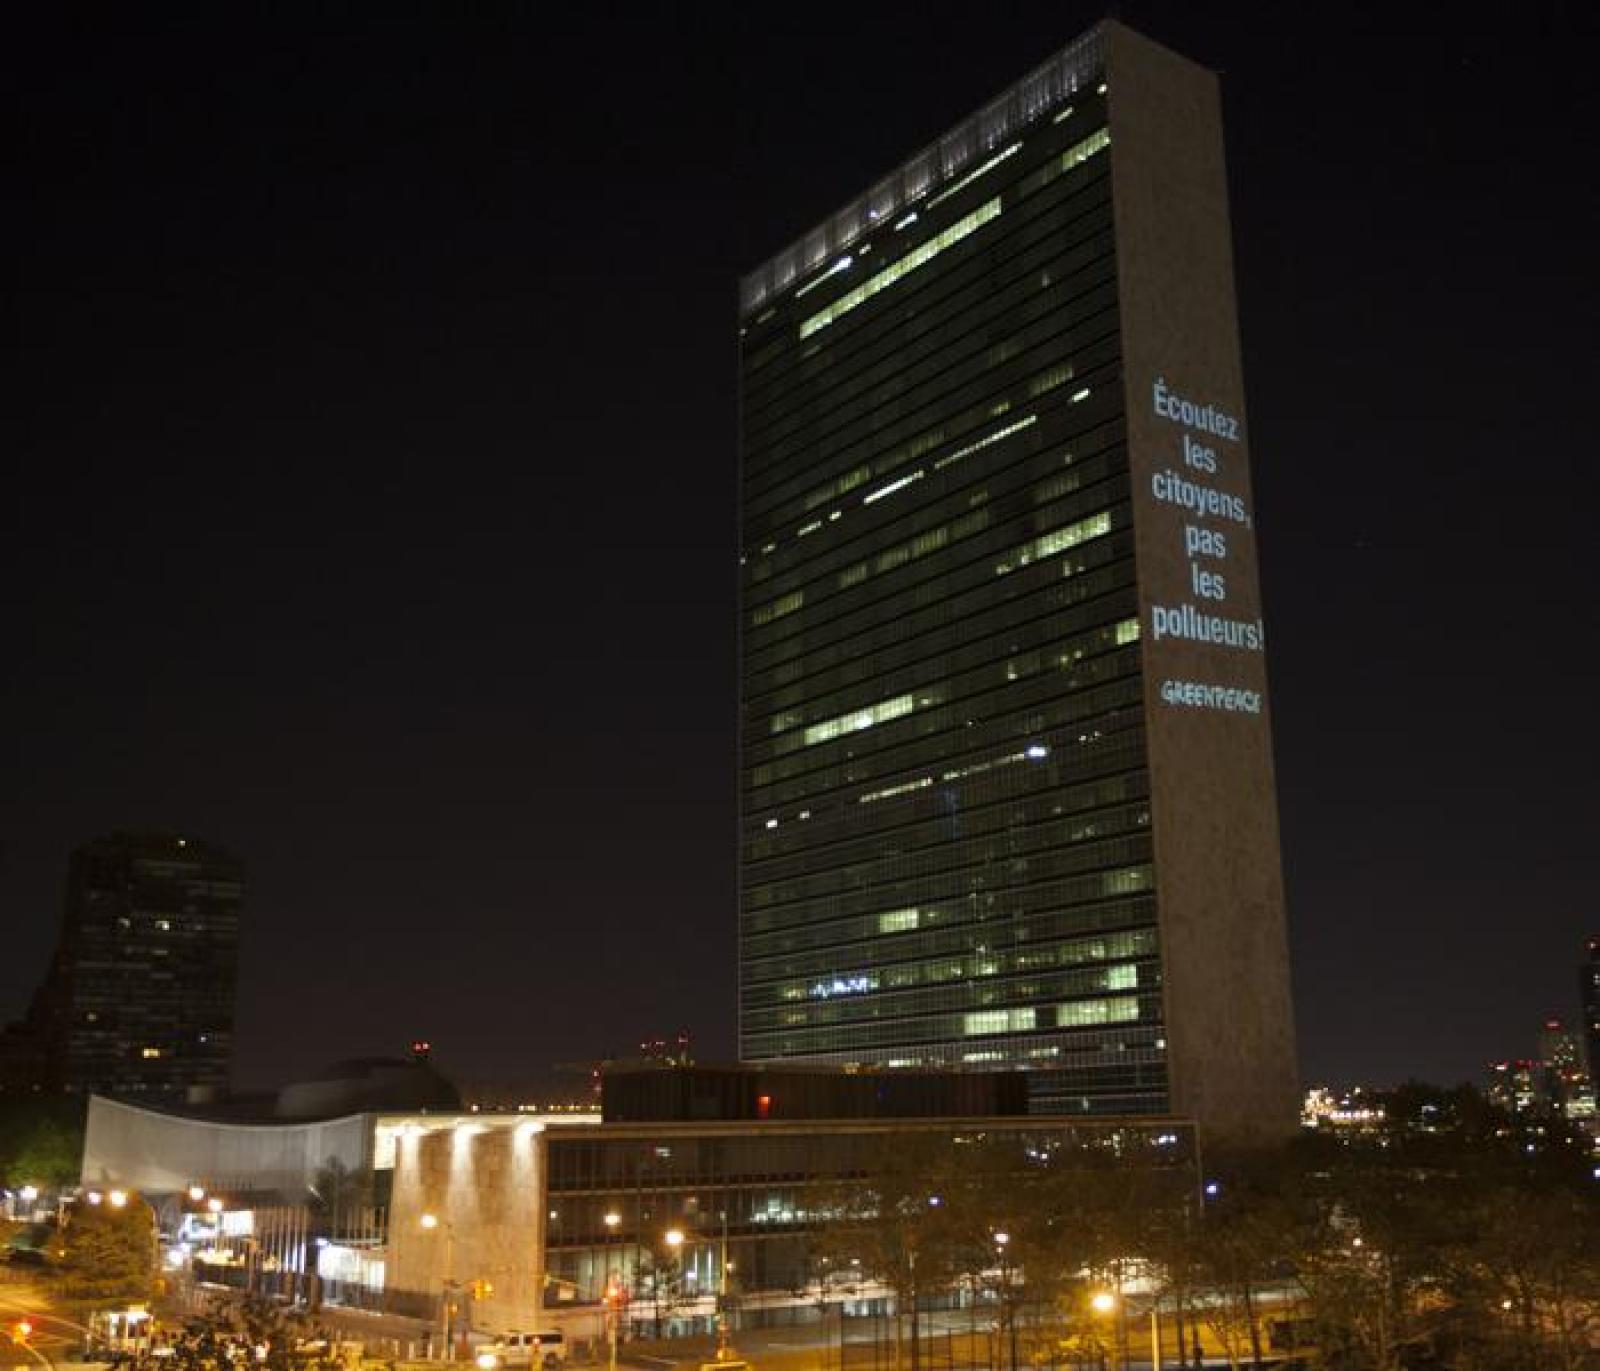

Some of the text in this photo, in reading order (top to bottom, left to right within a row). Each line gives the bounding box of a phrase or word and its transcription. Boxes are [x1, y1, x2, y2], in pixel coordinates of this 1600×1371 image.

[1153, 376, 1240, 442] Écoutez
[1183, 434, 1217, 473] les
[1186, 524, 1226, 559] pas
[1191, 562, 1225, 601] les
